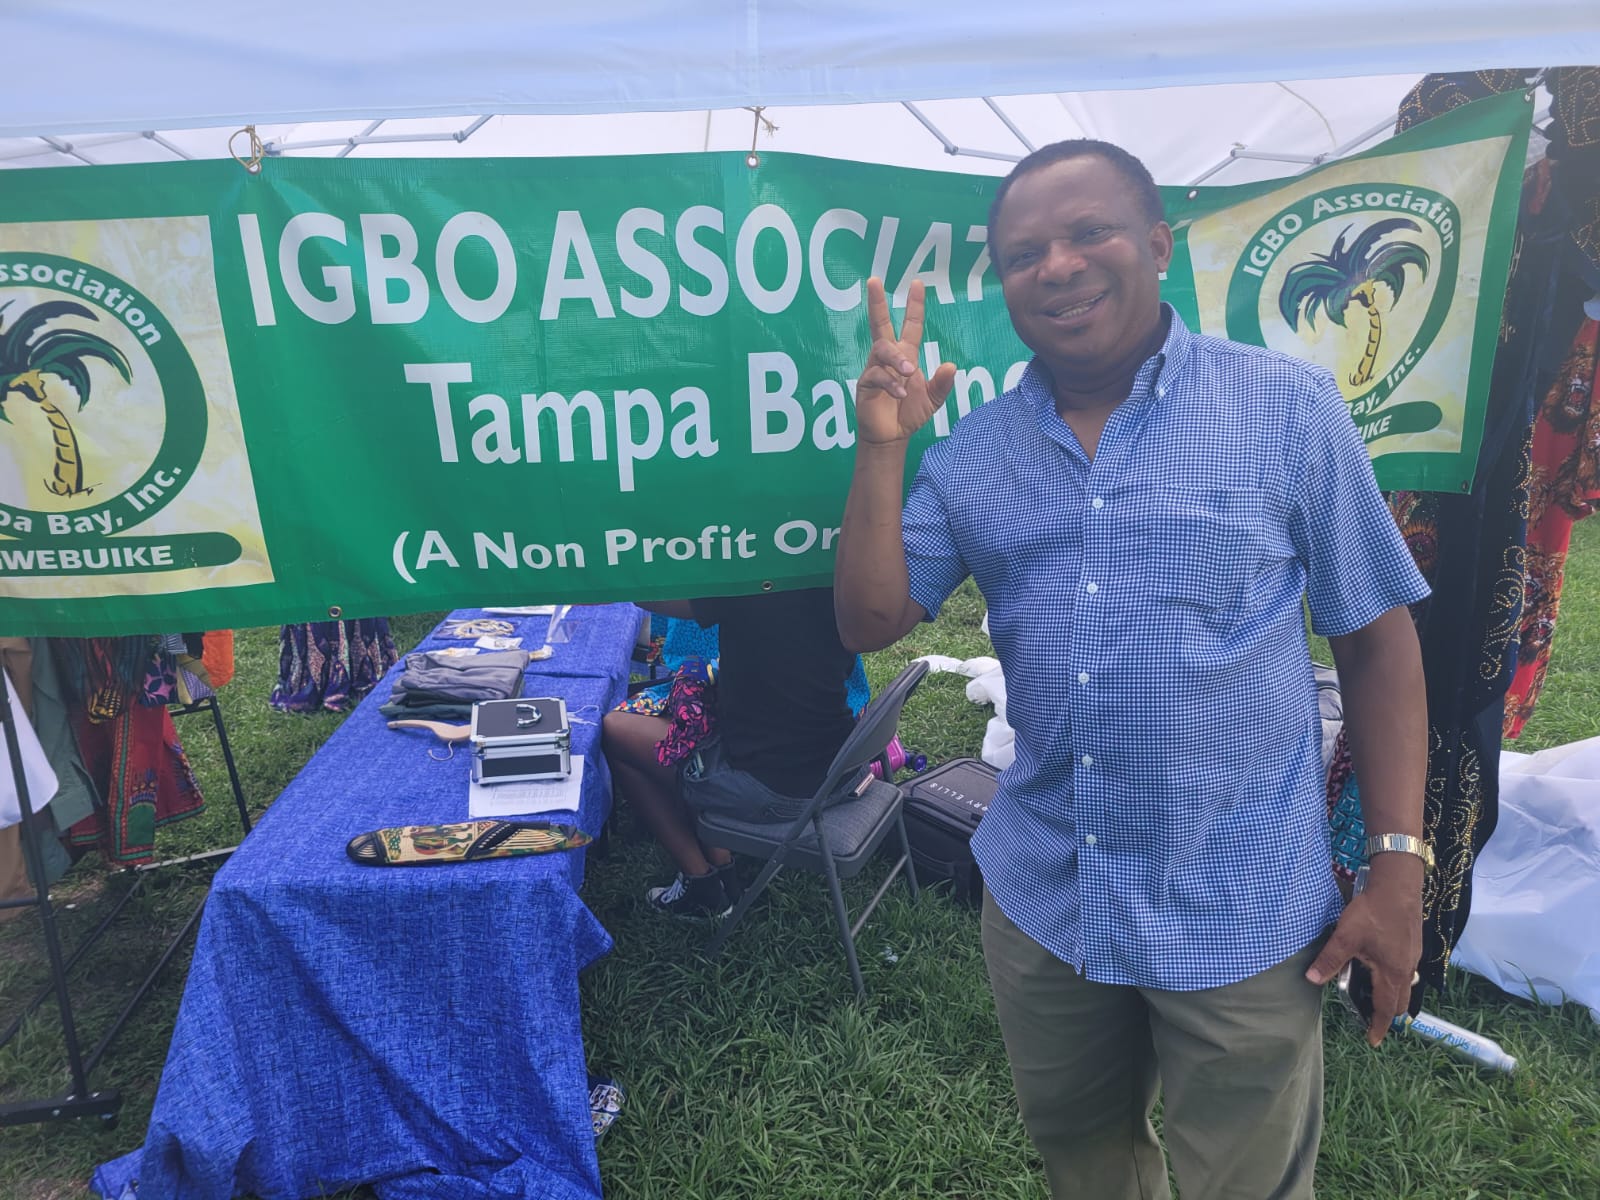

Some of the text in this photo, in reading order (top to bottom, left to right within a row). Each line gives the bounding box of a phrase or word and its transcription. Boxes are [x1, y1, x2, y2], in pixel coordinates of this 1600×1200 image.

[238, 203, 990, 327] IGBO ASSOCIAT
[1242, 190, 1455, 278] IGBO Association
[1386, 347, 1421, 390] Inc.
[404, 362, 719, 492] Tampa
[747, 351, 858, 454] Ba
[47, 509, 124, 536] Bay,
[123, 466, 182, 512] Inc.
[0, 545, 174, 571] WEBUIKE
[392, 519, 841, 584] (A Non Profit Or
[930, 783, 964, 800] ELLIS
